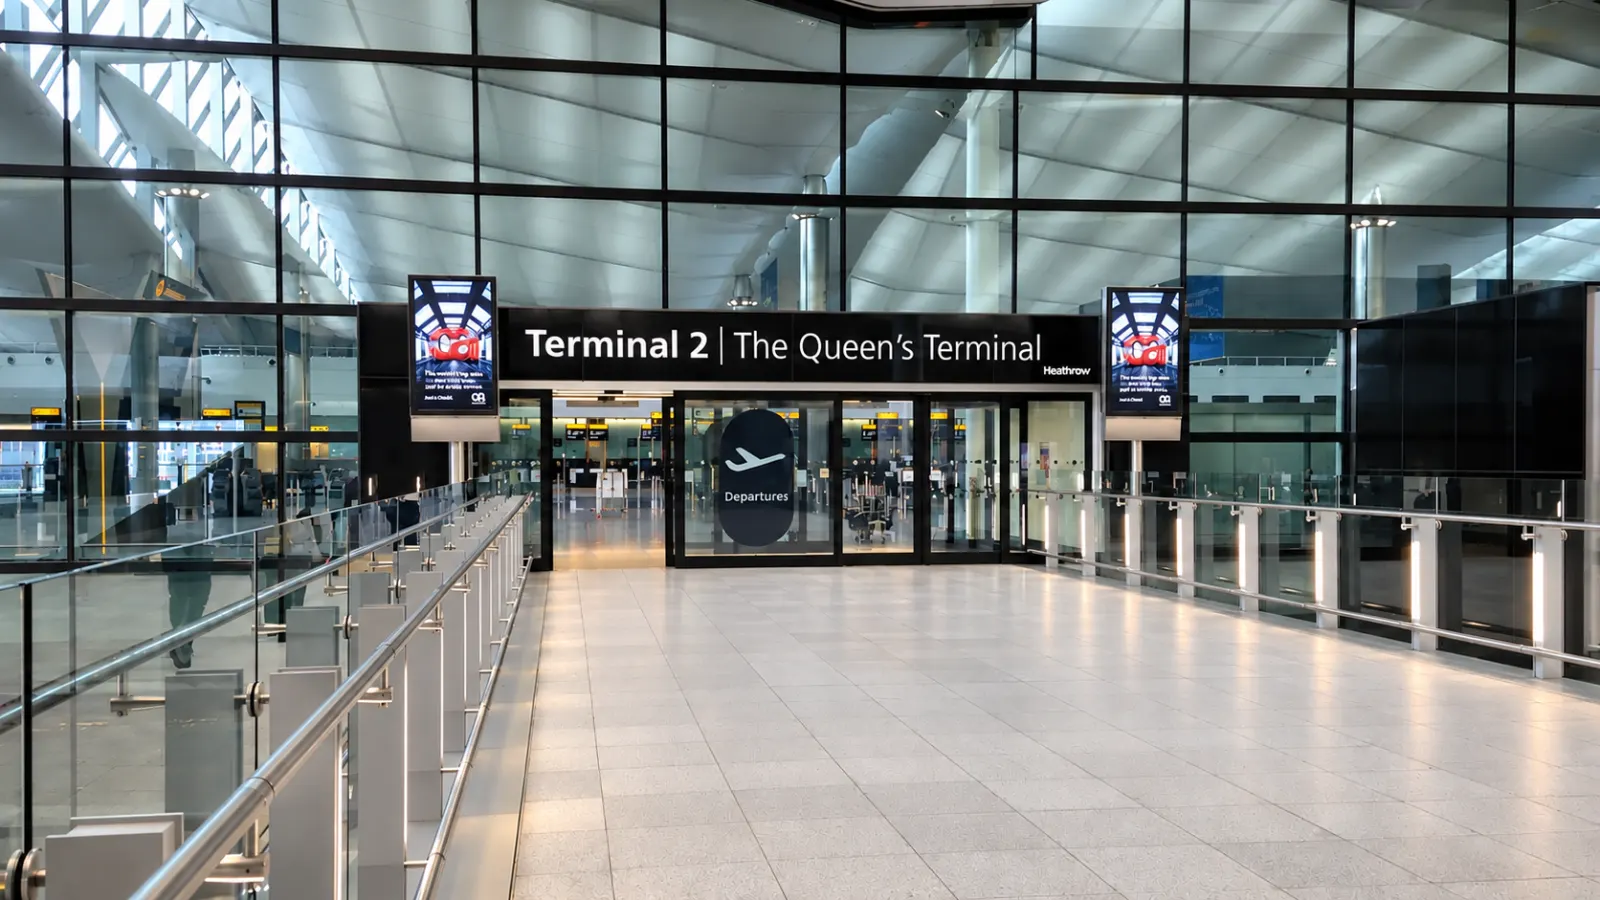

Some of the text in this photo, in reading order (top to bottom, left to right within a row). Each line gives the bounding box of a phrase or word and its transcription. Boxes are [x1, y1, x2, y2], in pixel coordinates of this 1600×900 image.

[524, 329, 678, 359] Terminal
[690, 332, 709, 359] 2
[734, 330, 788, 360] The
[923, 334, 1041, 361] Terminal
[1043, 365, 1091, 377] Heathrow
[725, 491, 789, 504] Departures
